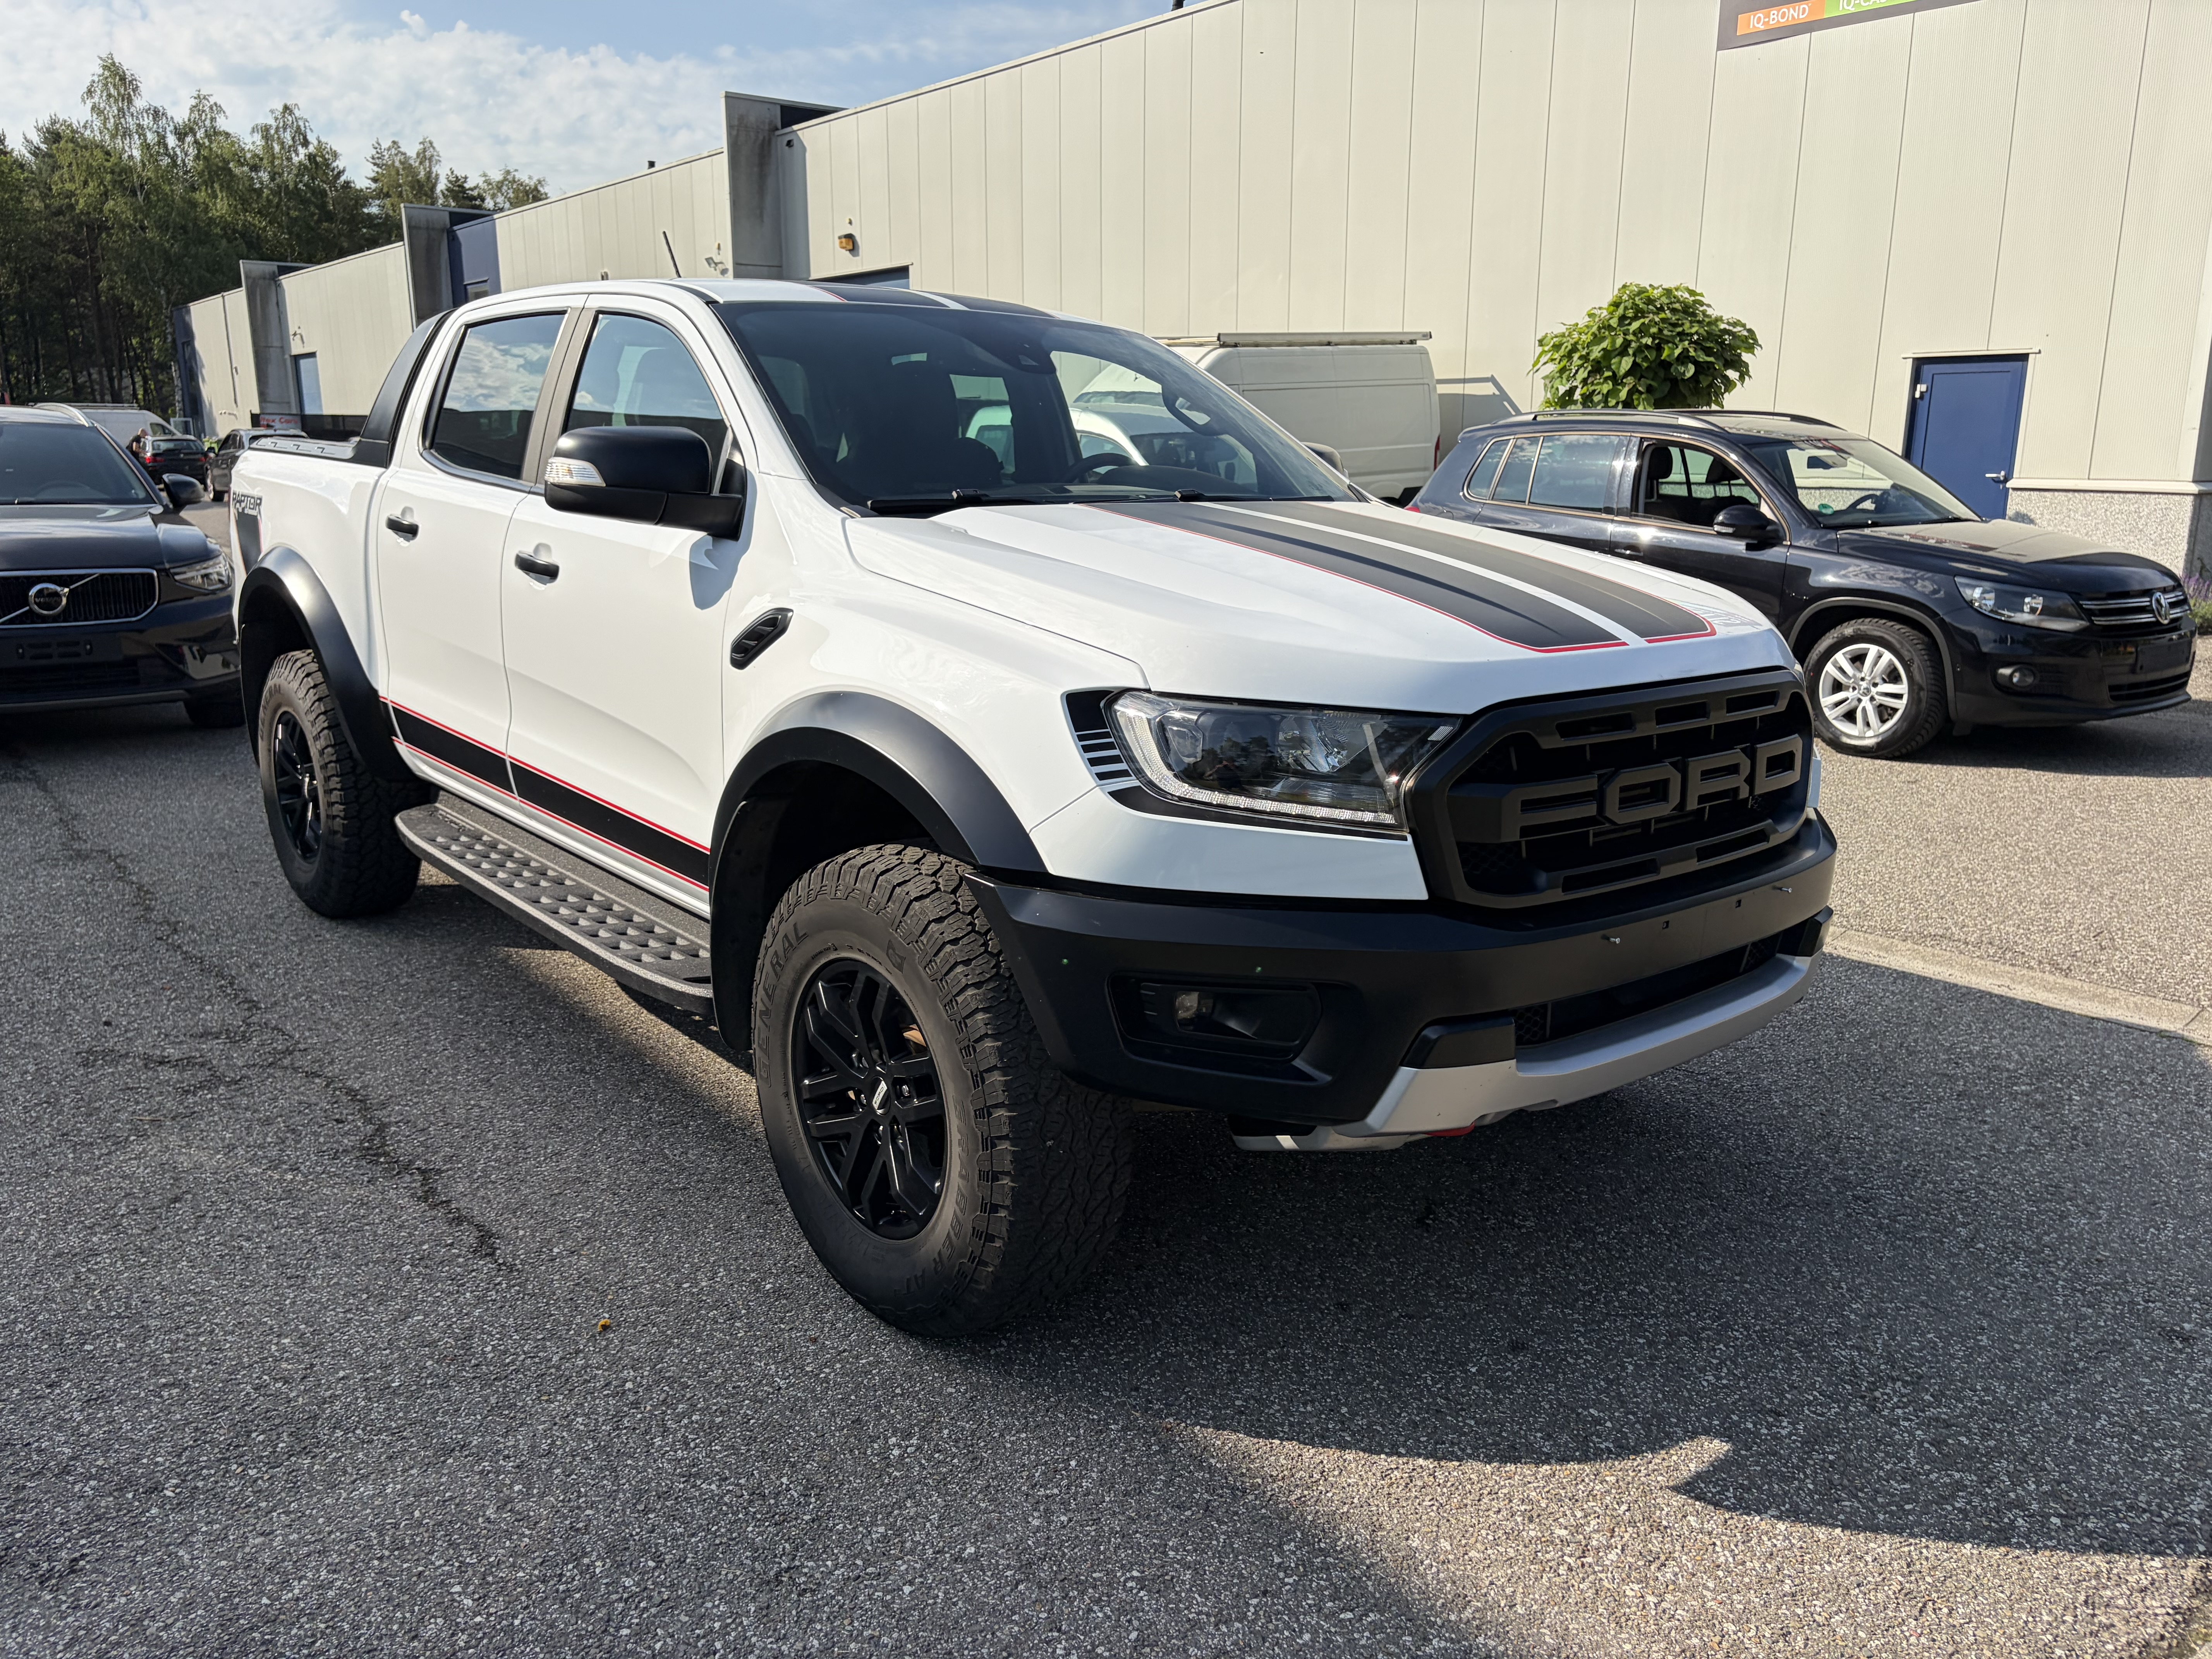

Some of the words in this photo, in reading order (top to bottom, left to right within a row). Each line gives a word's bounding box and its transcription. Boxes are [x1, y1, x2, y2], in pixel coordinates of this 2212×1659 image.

[1750, 4, 1809, 29] IQ-BOND
[232, 491, 263, 515] RAPTOR
[1501, 734, 1803, 844] FORD
[757, 921, 809, 1088] GENERAL
[933, 1095, 969, 1276] GRABBER
